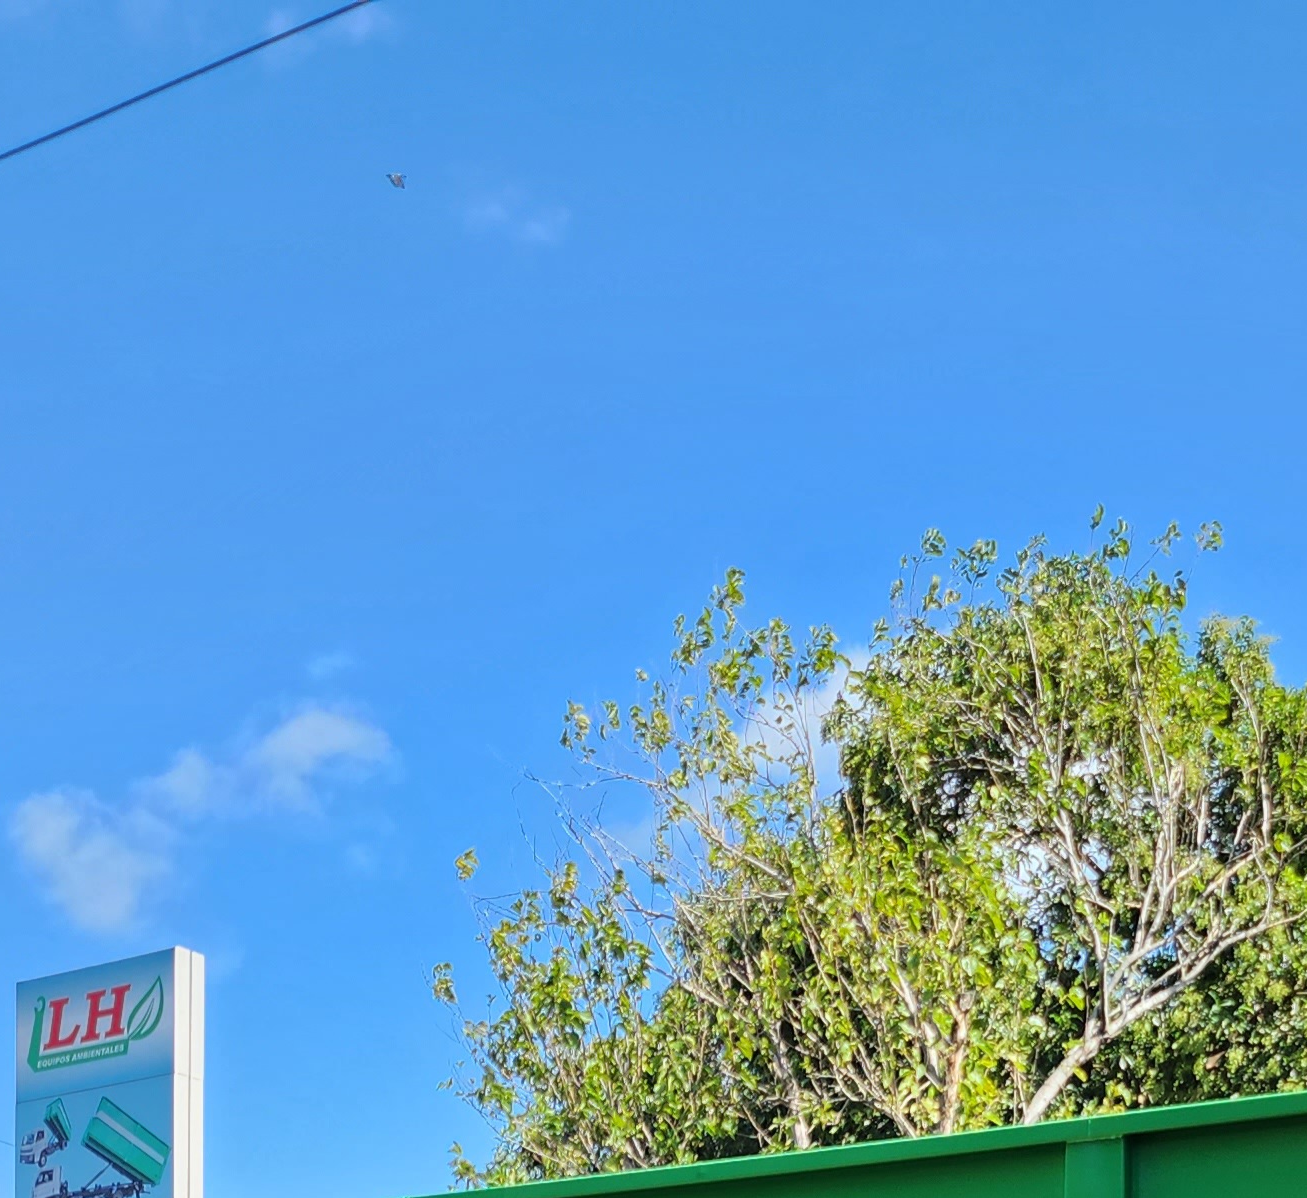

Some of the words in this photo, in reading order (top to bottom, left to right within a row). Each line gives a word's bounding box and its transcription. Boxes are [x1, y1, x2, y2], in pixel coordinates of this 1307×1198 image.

[43, 983, 132, 1051] LH
[37, 1054, 71, 1069] EQUIPOS
[71, 1043, 125, 1062] AMBIENTALES
